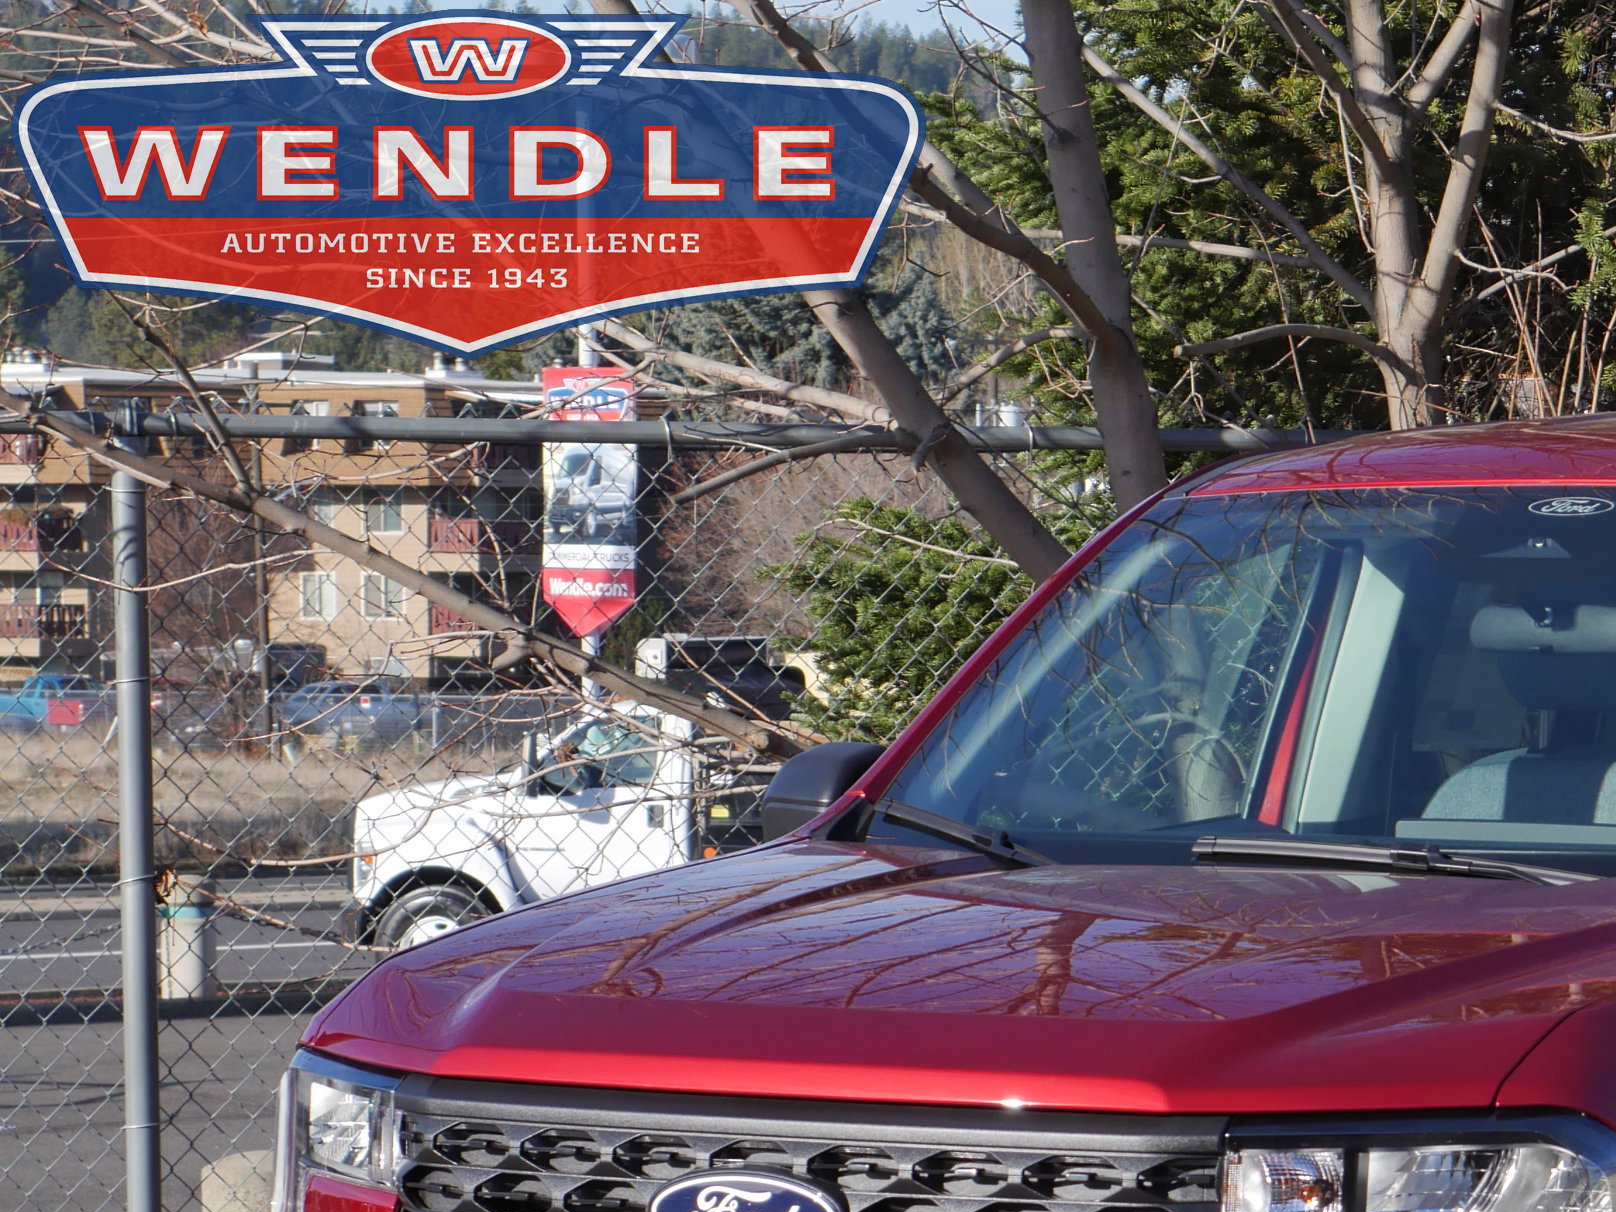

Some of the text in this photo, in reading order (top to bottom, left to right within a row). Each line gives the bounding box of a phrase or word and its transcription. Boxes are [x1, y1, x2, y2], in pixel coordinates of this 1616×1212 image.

[1541, 499, 1601, 513] Ford
[549, 551, 590, 561] MMERCIAL
[549, 577, 628, 597] Wendle.com
